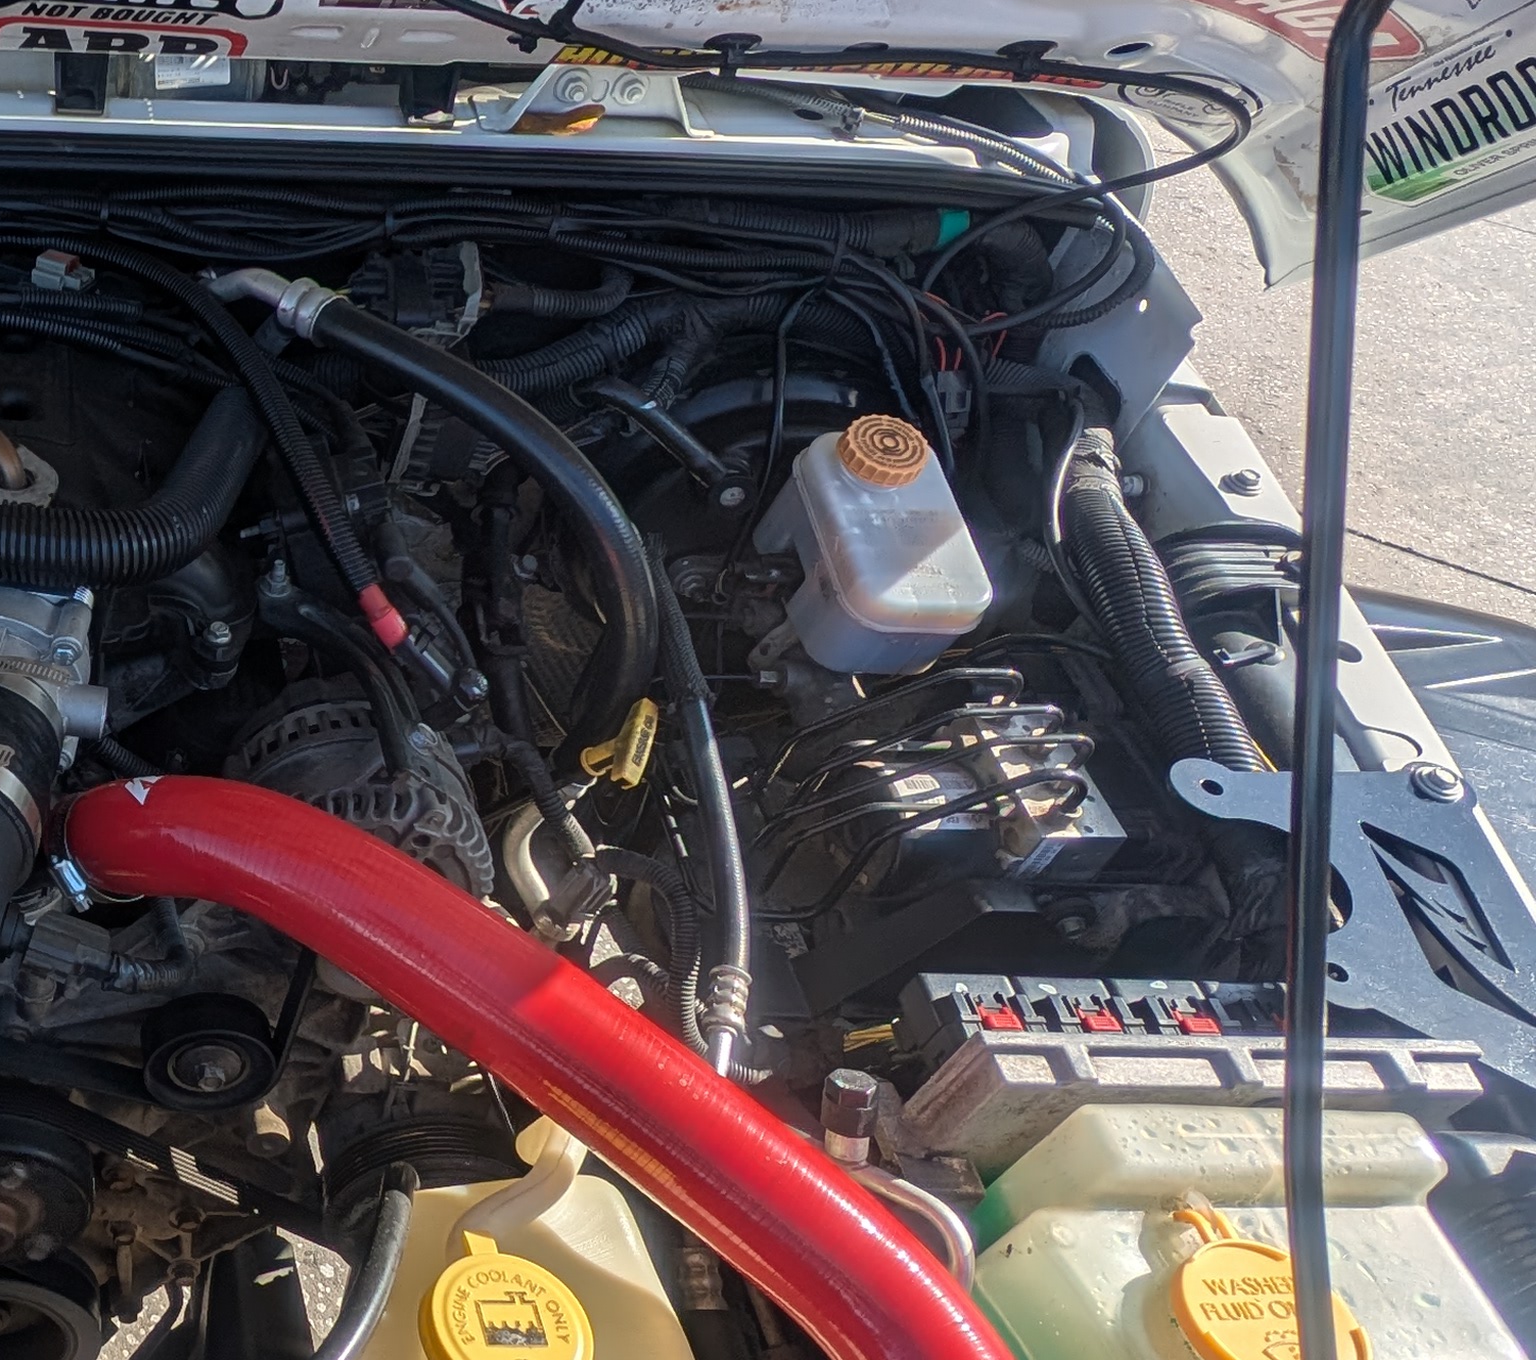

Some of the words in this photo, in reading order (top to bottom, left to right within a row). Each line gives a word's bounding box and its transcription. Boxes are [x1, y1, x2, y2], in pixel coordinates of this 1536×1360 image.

[22, 2, 88, 21] NOT
[94, 6, 219, 27] BOUGHT
[1385, 44, 1497, 114] Tennessee
[452, 1284, 475, 1346] ENGINE
[467, 1269, 547, 1298] COOLANT
[545, 1298, 571, 1345] ONLY
[1199, 1301, 1265, 1322] FLUID
